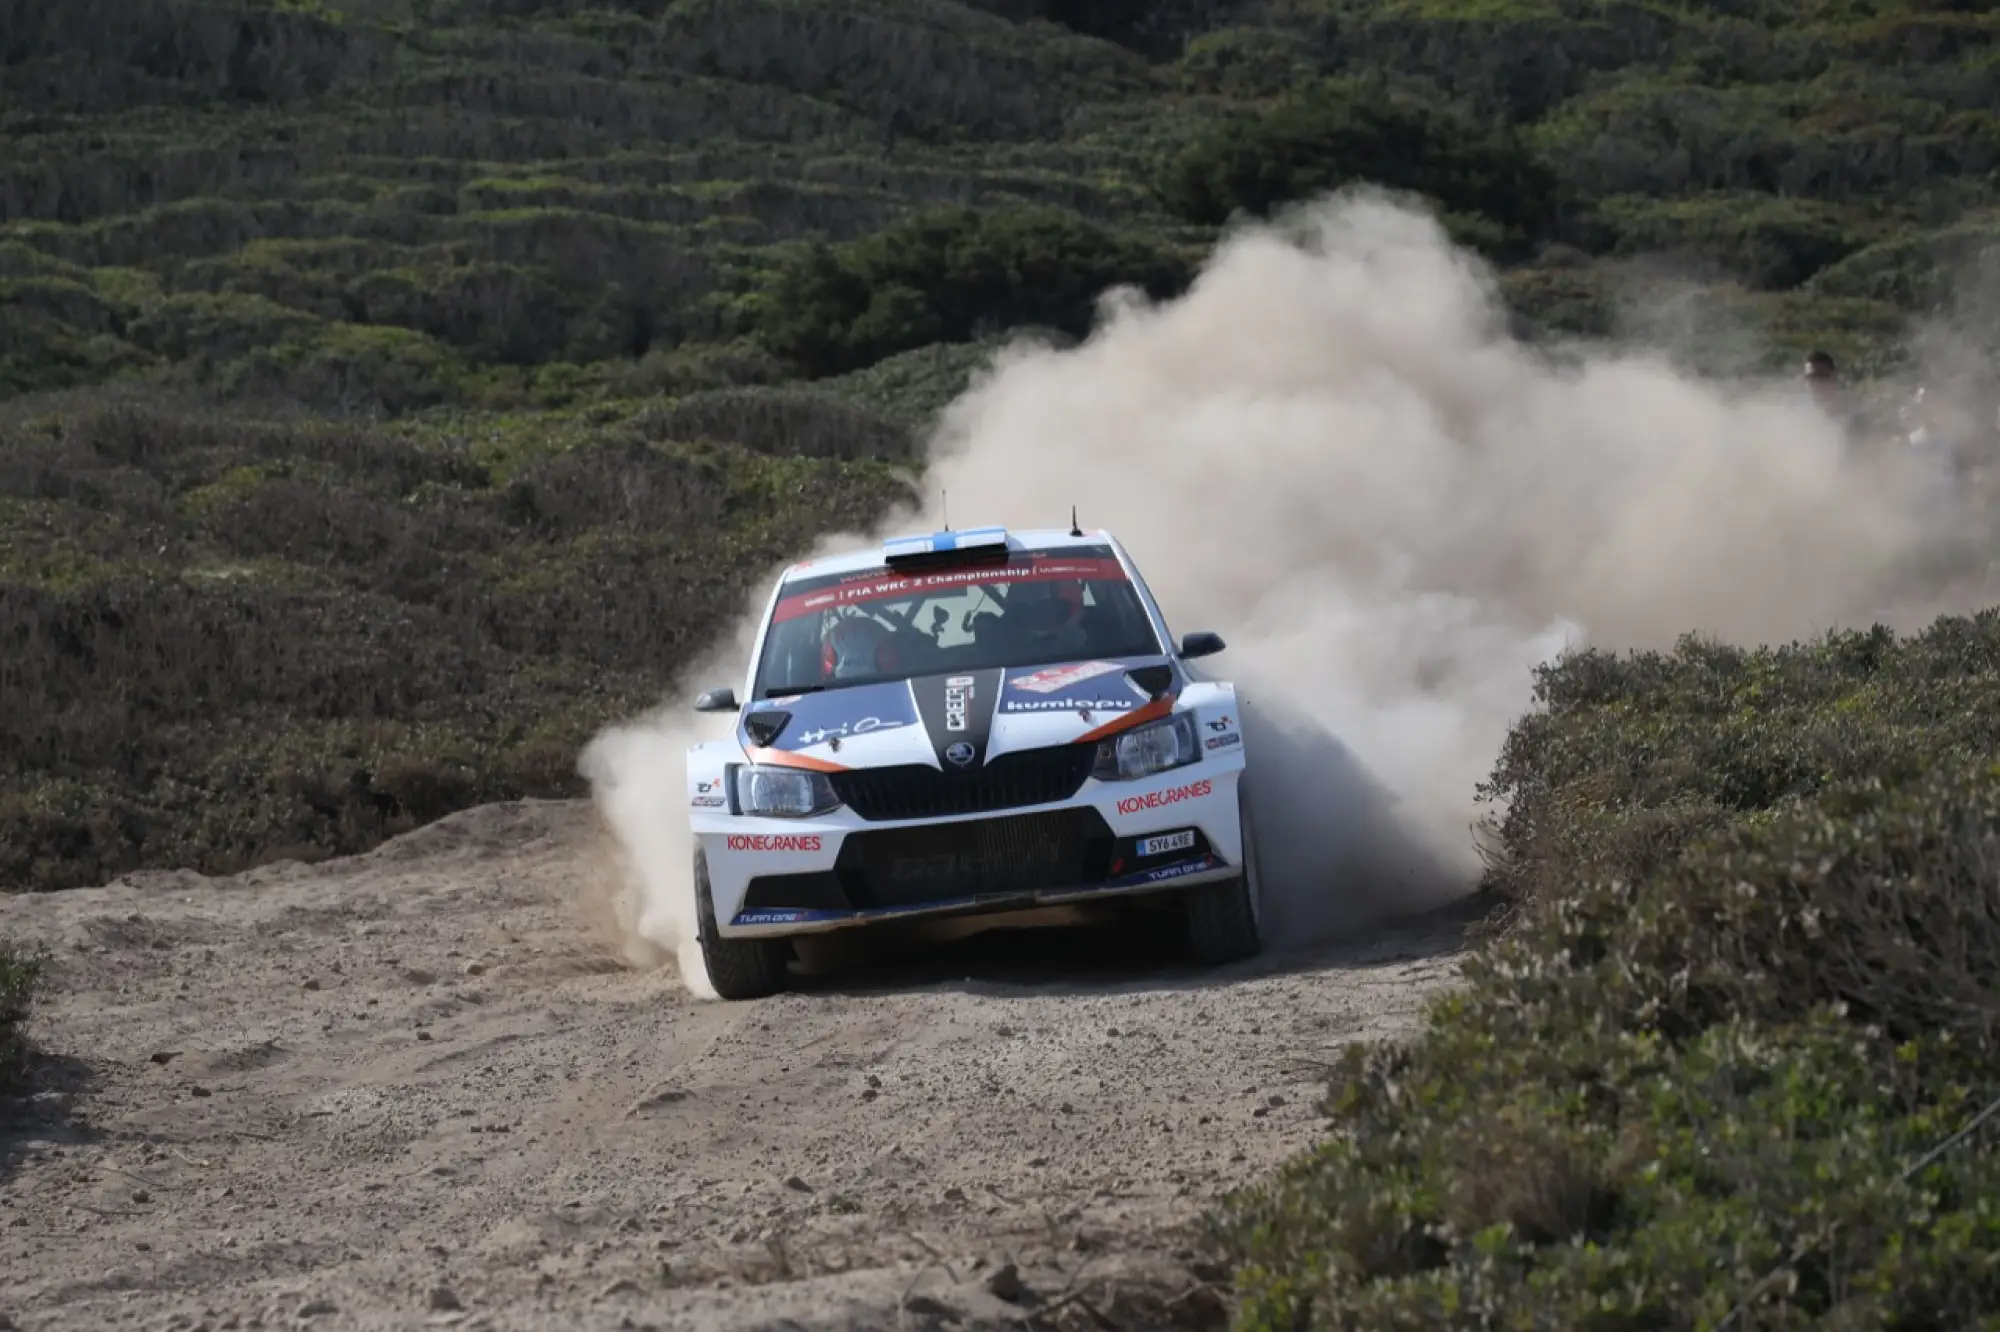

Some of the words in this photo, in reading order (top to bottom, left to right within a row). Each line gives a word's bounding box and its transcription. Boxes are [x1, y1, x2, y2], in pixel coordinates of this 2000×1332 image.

[847, 587, 872, 599] FIA
[875, 580, 909, 592] WRC
[913, 577, 923, 586] 2
[927, 568, 1030, 584] Championship
[1117, 780, 1212, 815] KONECRANES
[727, 835, 821, 851] KONECRANES
